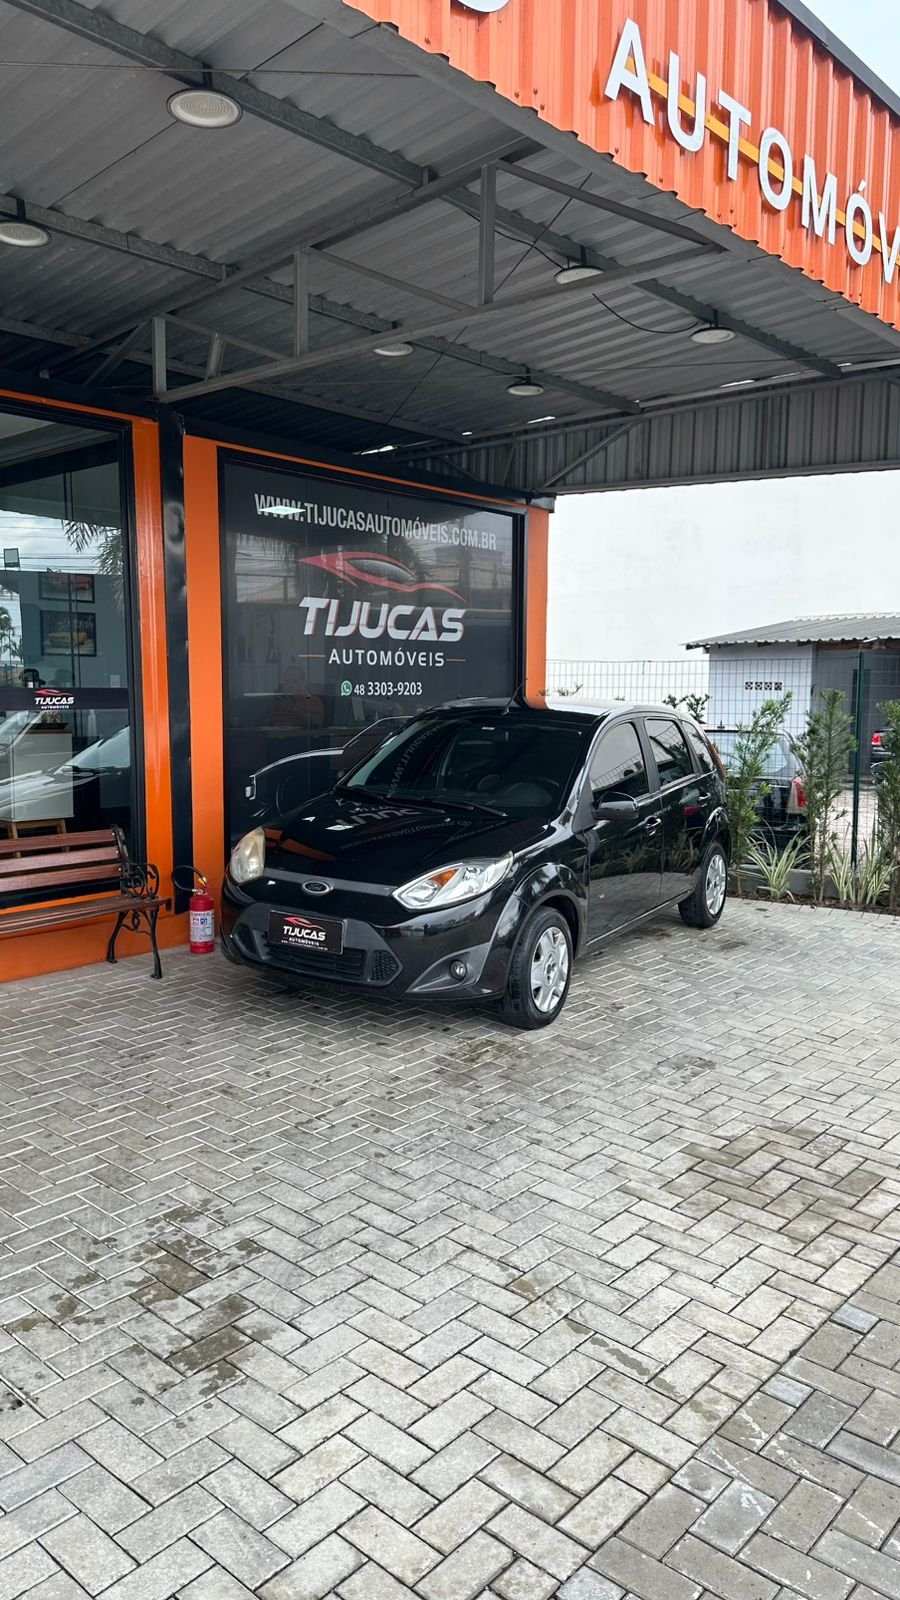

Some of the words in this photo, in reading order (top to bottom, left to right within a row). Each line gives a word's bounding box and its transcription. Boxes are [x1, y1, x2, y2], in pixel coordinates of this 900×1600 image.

[299, 597, 466, 642] TIJUCAS
[328, 648, 445, 667] AUTOMÓVEIS
[353, 684, 366, 696] 48
[367, 681, 423, 696] 3303-9203
[35, 697, 75, 705] TIJUCAS
[283, 925, 326, 941] TIJUCAS
